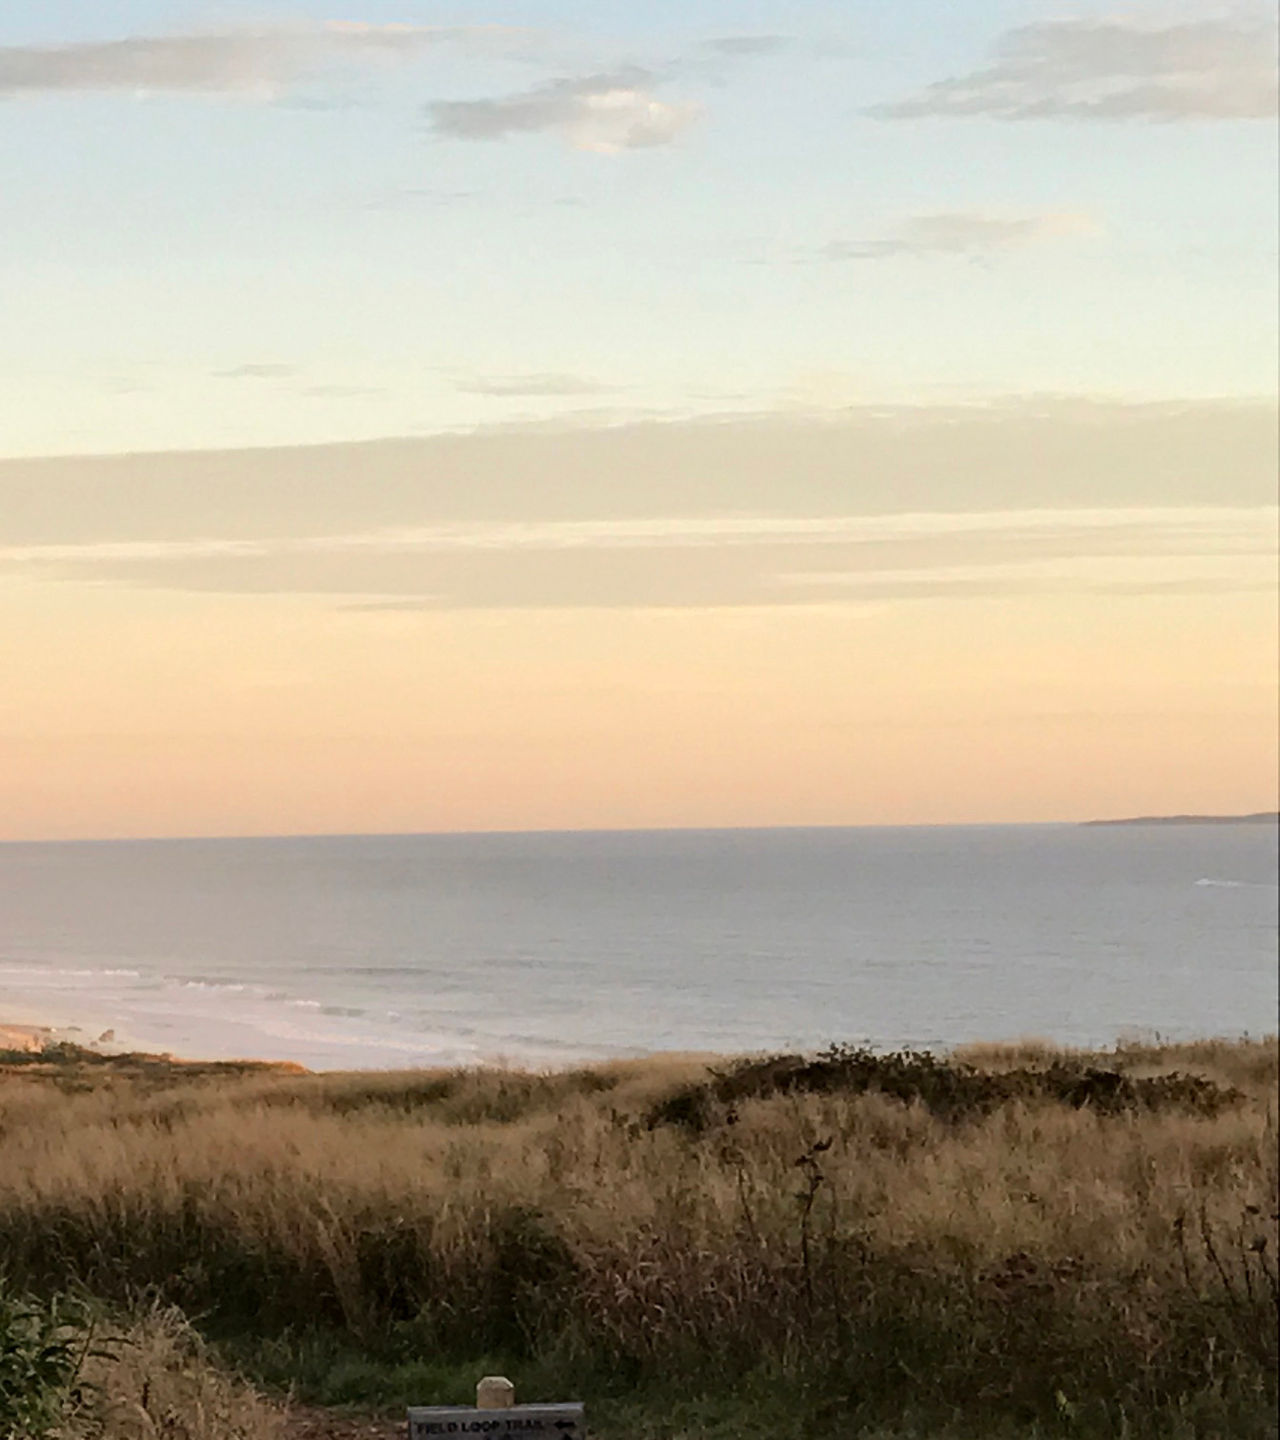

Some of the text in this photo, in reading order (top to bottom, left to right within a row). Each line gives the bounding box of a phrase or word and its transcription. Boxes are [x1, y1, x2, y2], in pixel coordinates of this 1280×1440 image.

[416, 1419, 544, 1434] FIELD LOOP TRAIL
